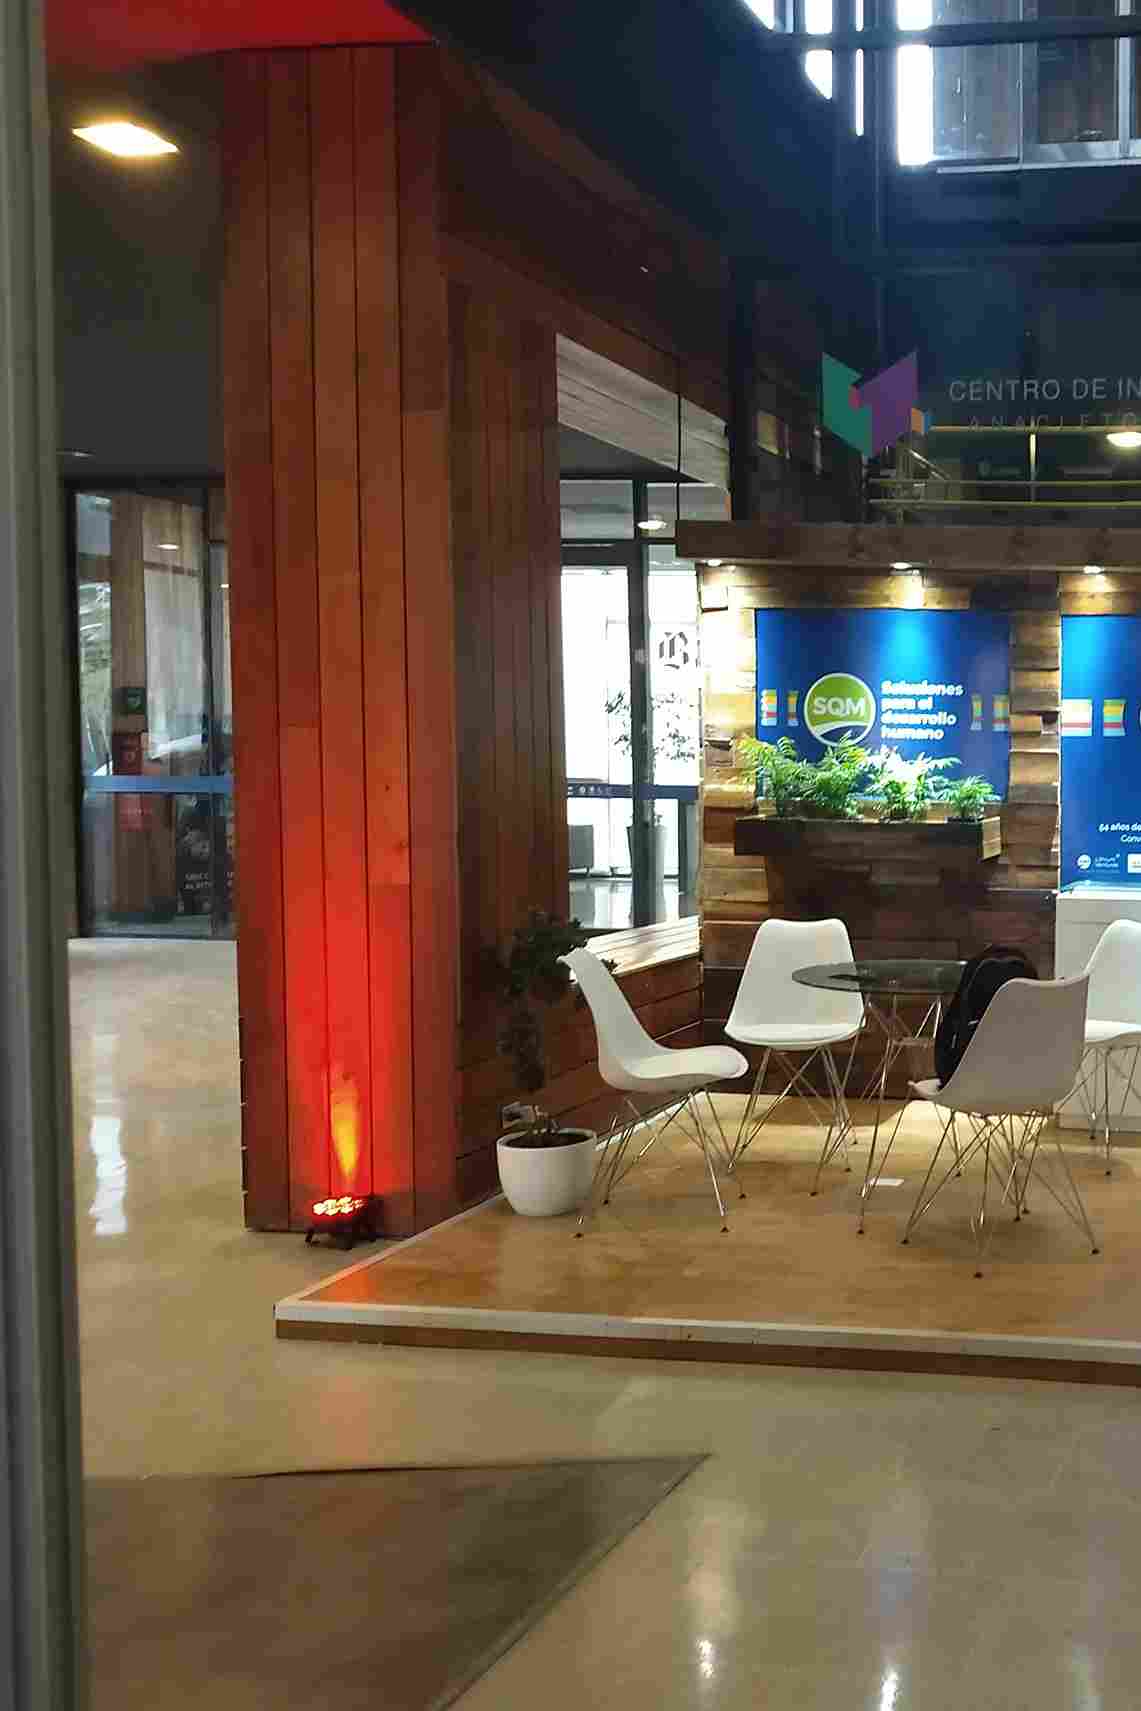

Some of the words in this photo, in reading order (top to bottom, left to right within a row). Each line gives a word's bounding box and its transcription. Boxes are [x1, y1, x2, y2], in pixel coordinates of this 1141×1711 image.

[949, 377, 1062, 402] CENTRO
[1072, 378, 1105, 401] DE
[881, 680, 964, 696] Soluciones
[812, 696, 867, 718] SQM
[881, 698, 916, 712] para
[917, 696, 933, 710] el
[881, 710, 957, 725] desarrollo
[881, 725, 945, 740] humano
[1110, 822, 1130, 832] años
